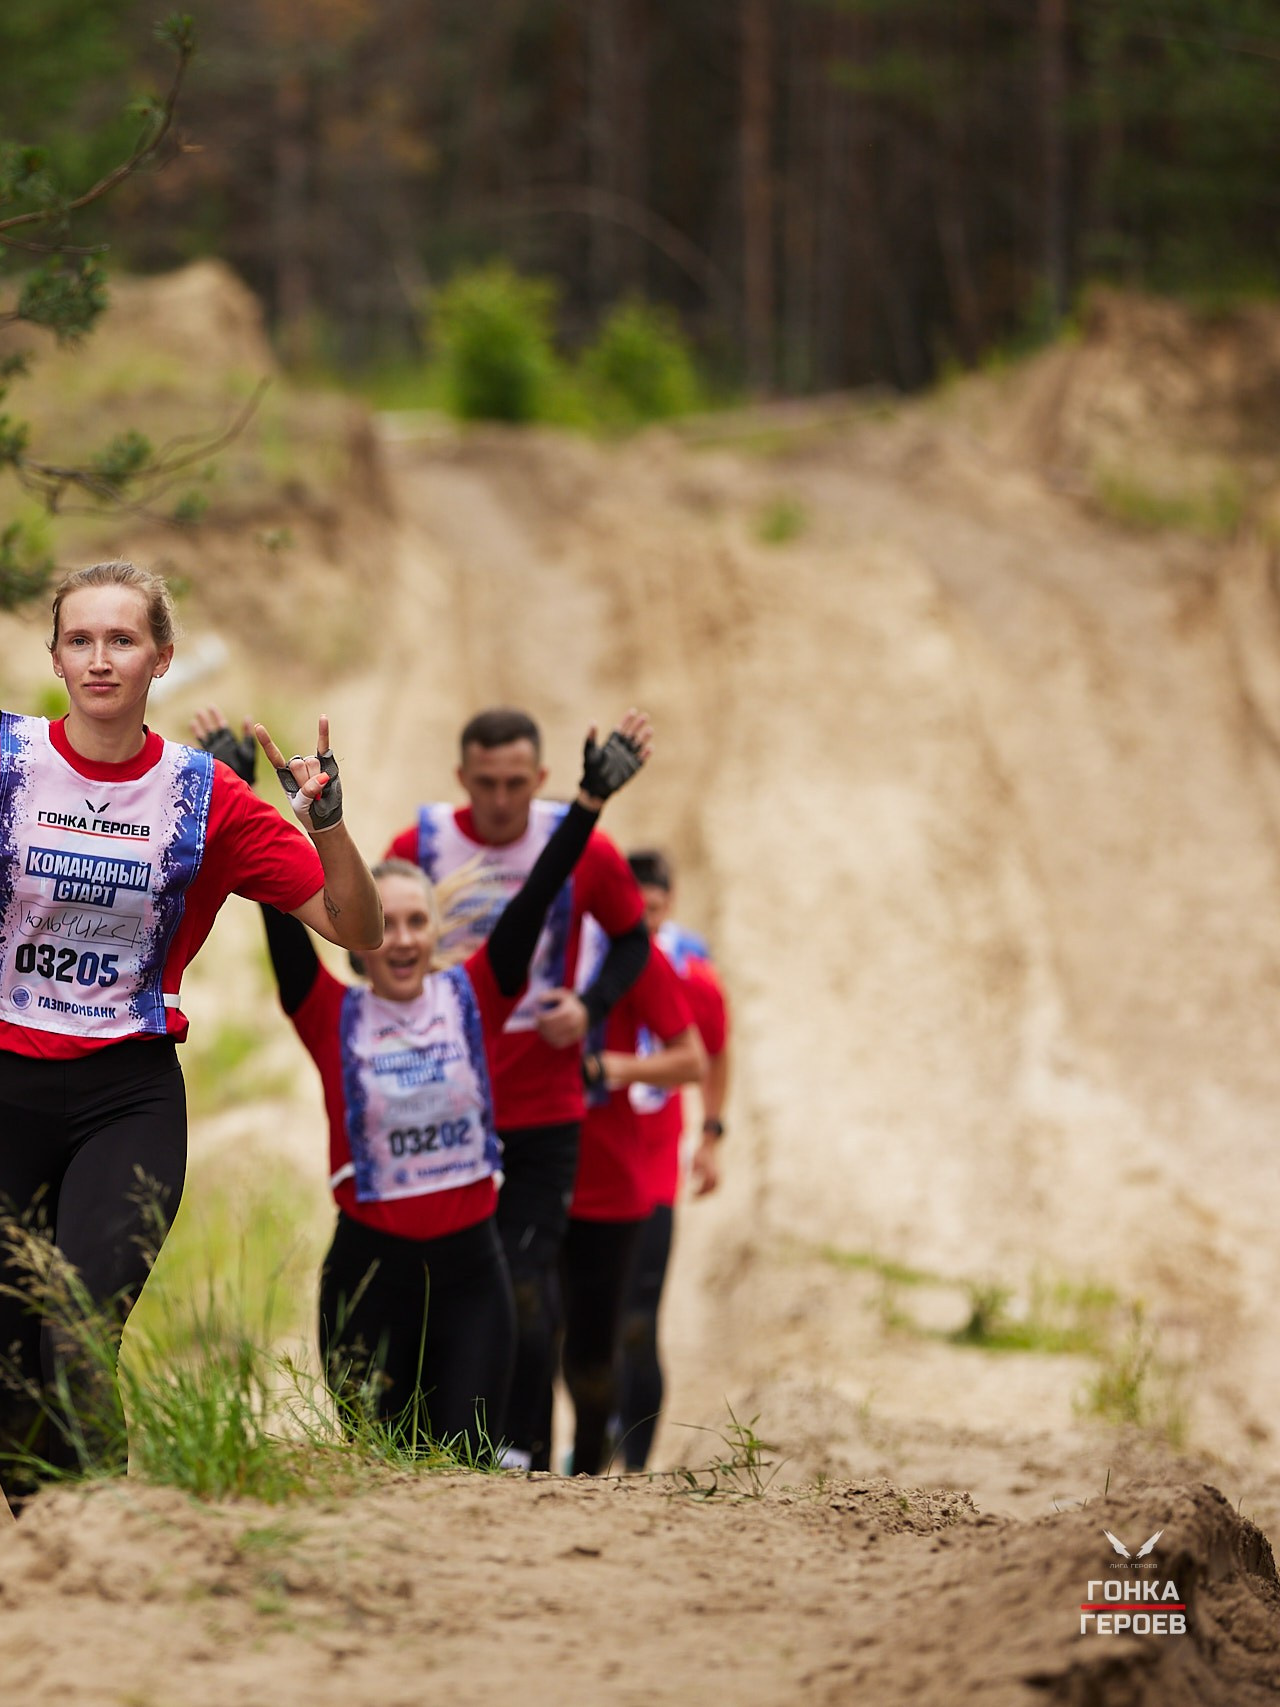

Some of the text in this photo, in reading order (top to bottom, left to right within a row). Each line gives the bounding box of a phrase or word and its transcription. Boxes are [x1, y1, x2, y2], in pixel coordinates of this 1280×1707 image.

[37, 810, 151, 838] ГОНКА ГЕРОЕВ
[28, 850, 150, 888] КОМАНДНЫЙ
[57, 882, 114, 906] СТАРТ
[15, 942, 120, 988] 03205
[37, 995, 117, 1019] ГАЗПРОМБАНК
[388, 1118, 473, 1158] 03202
